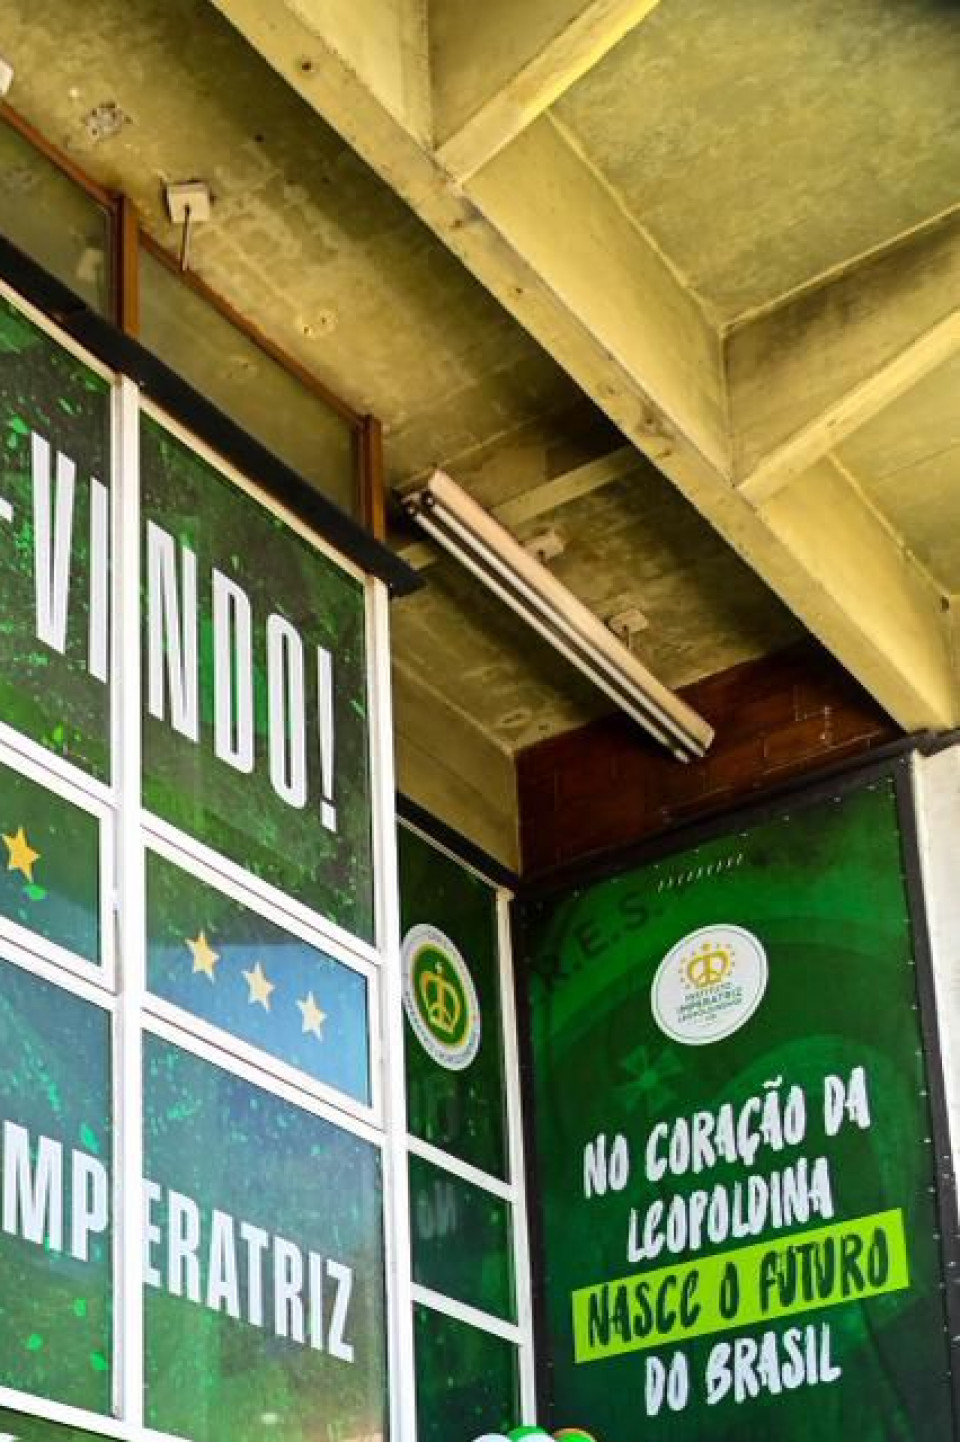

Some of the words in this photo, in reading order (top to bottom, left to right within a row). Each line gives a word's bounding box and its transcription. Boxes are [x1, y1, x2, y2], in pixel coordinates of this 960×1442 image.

[583, 1132, 630, 1199] NO
[645, 1075, 807, 1183] CORAÇÃO
[823, 1065, 872, 1137] DA
[627, 1156, 835, 1262] LEOPOLDINA
[589, 1269, 703, 1348] NASCE
[719, 1261, 740, 1320] O
[759, 1226, 890, 1313] FUTURO
[644, 1351, 690, 1417] DO
[705, 1321, 843, 1405] BRASIL
